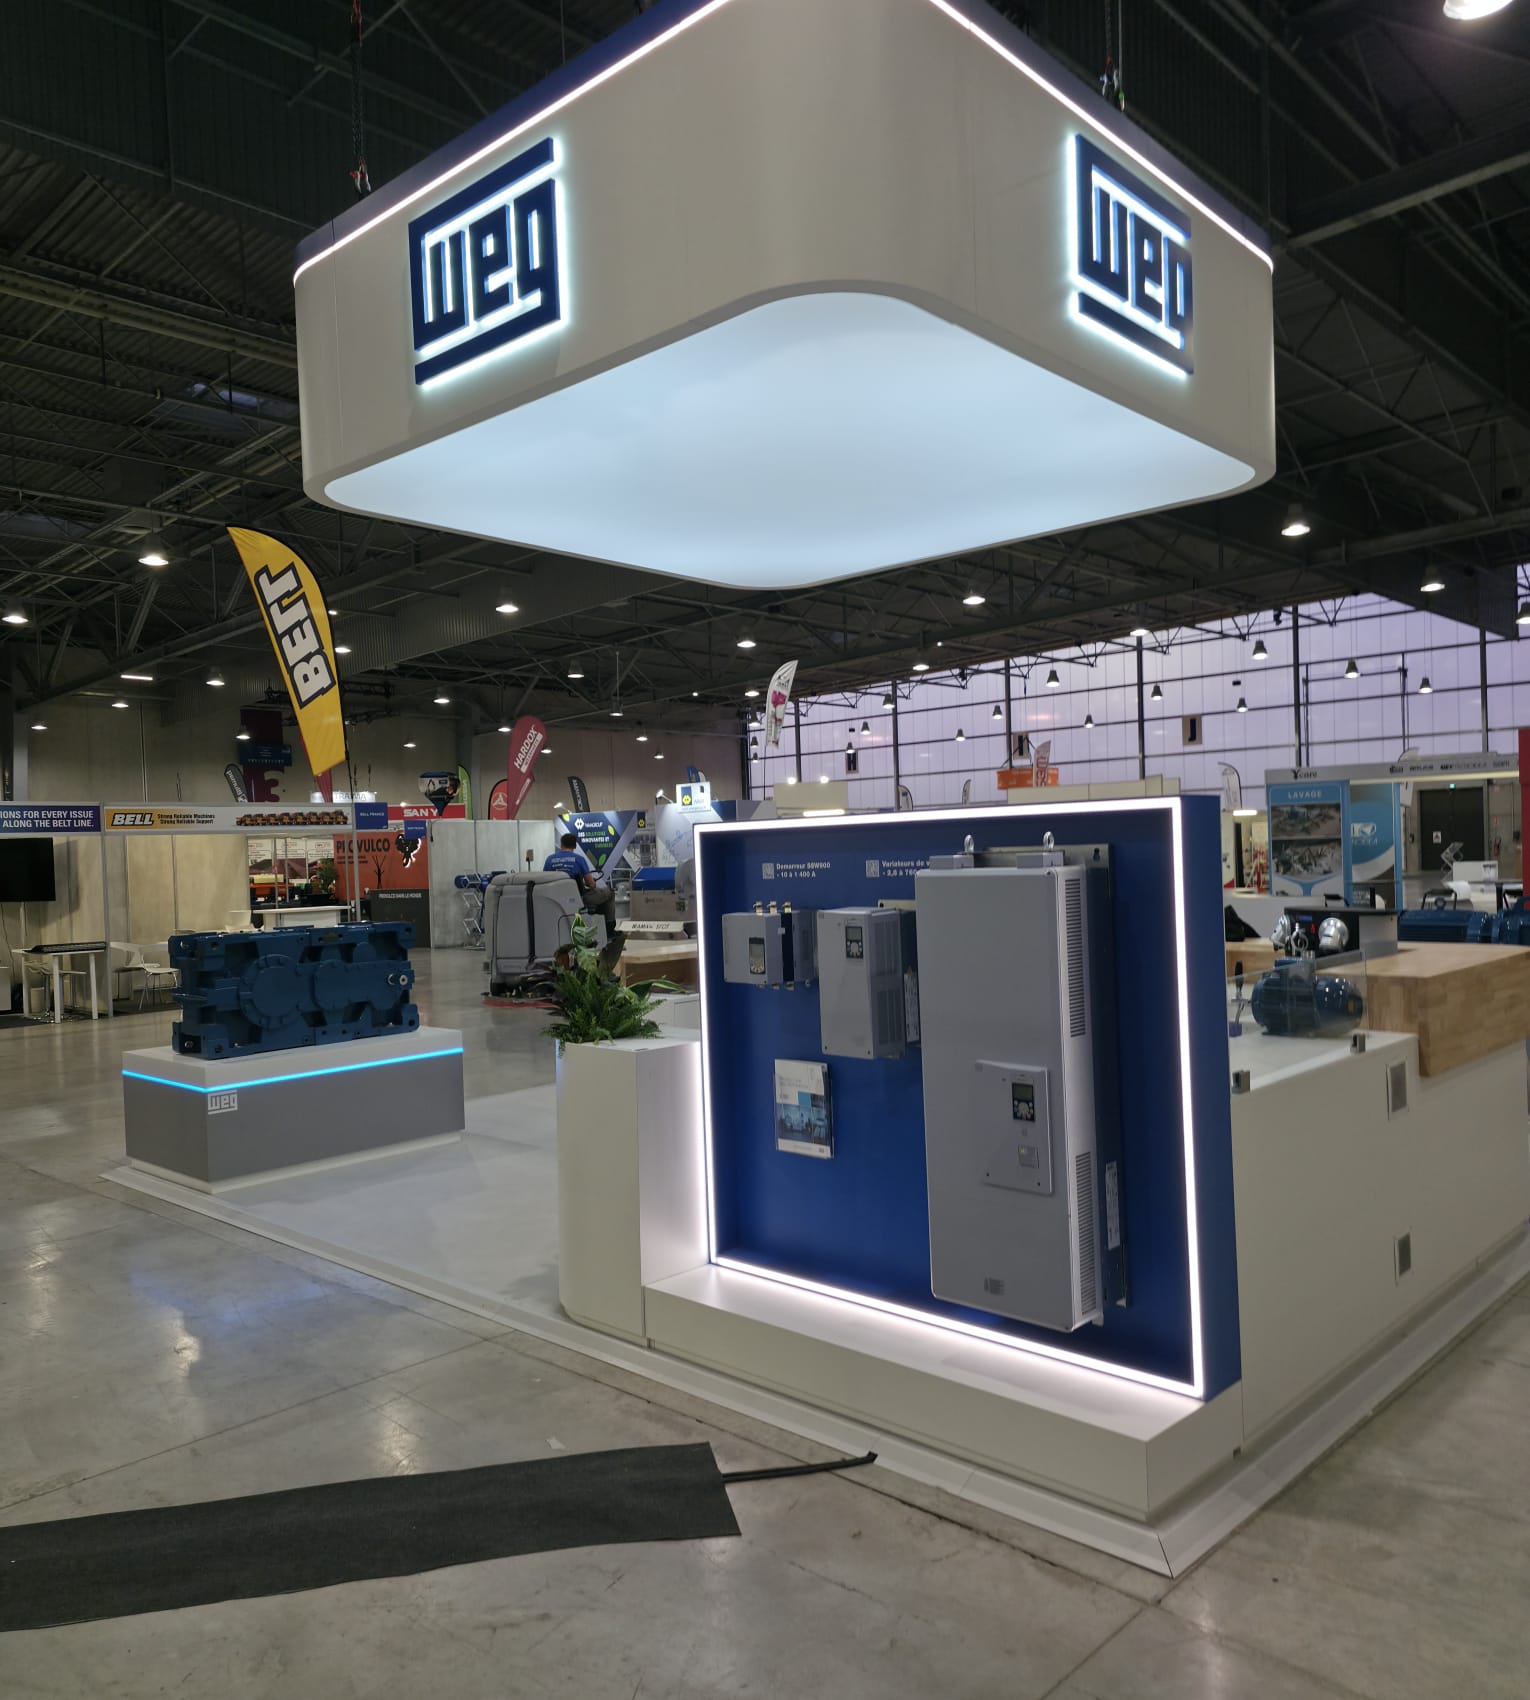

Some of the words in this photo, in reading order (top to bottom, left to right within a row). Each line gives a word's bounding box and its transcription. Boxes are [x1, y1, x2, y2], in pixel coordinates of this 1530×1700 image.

[514, 727, 538, 769] HARDOX
[1288, 790, 1322, 800] LAVAGE
[23, 810, 39, 819] FOR
[41, 810, 67, 819] EVERY
[70, 810, 94, 819] ISSUE
[403, 808, 438, 817] SANY
[3, 819, 32, 828] ALONG
[34, 819, 51, 828] THE
[52, 819, 71, 827] BELT
[74, 819, 94, 828] LINE.
[111, 813, 154, 826] BELL
[881, 859, 915, 868] Variateurs
[916, 859, 924, 867] de
